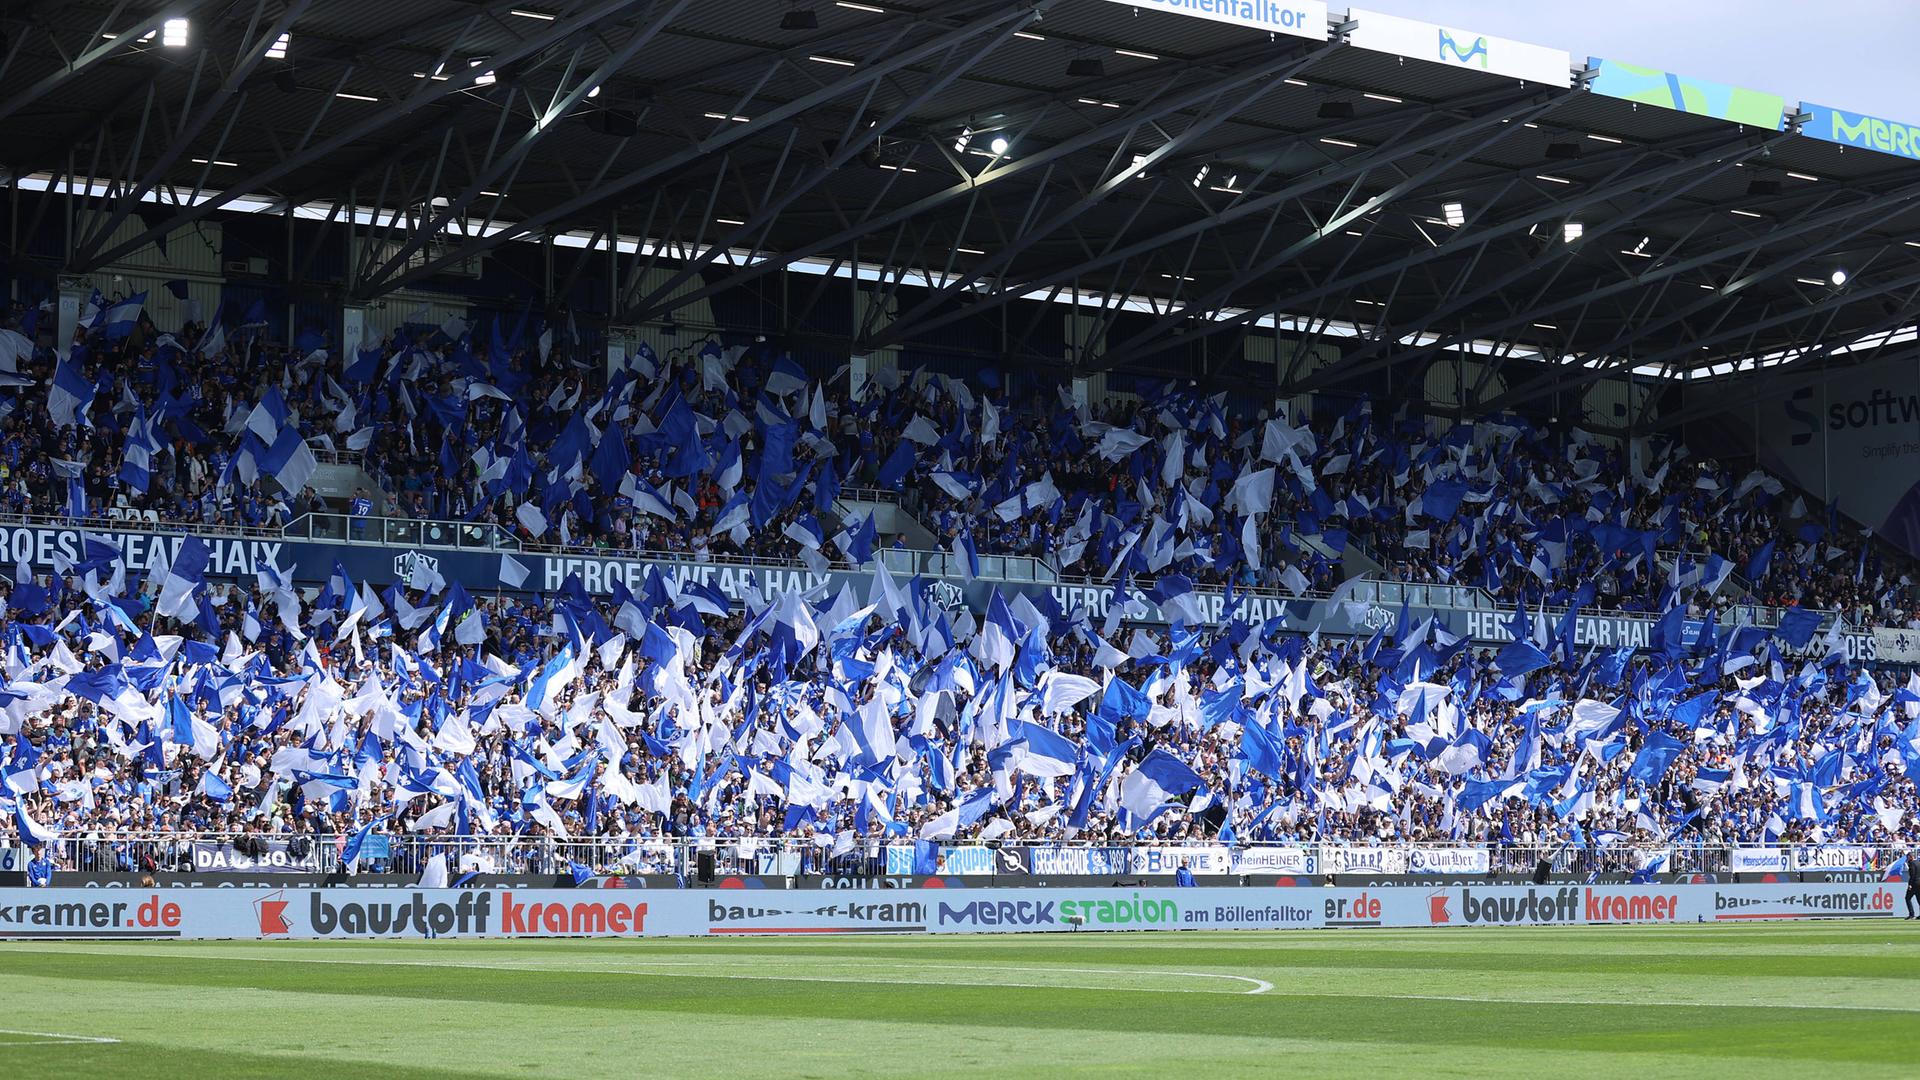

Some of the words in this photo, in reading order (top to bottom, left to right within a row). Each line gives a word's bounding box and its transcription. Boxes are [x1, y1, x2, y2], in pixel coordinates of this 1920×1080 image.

[1, 854, 15, 870] 6
[198, 850, 228, 868] DA
[763, 854, 775, 874] 7
[1034, 849, 1090, 875] GEGENGERADE
[1231, 854, 1300, 866] RheinHEINER
[1306, 857, 1315, 873] 8
[1781, 856, 1788, 871] 9
[1812, 848, 1846, 867] Ried
[310, 892, 491, 935] baustoff
[502, 892, 647, 933] kramer
[1184, 910, 1209, 923] am
[1215, 904, 1313, 923] Böllenfalltor
[1325, 892, 1382, 919] er.de
[1463, 887, 1579, 922] baustoff
[1586, 887, 1678, 920] kramer
